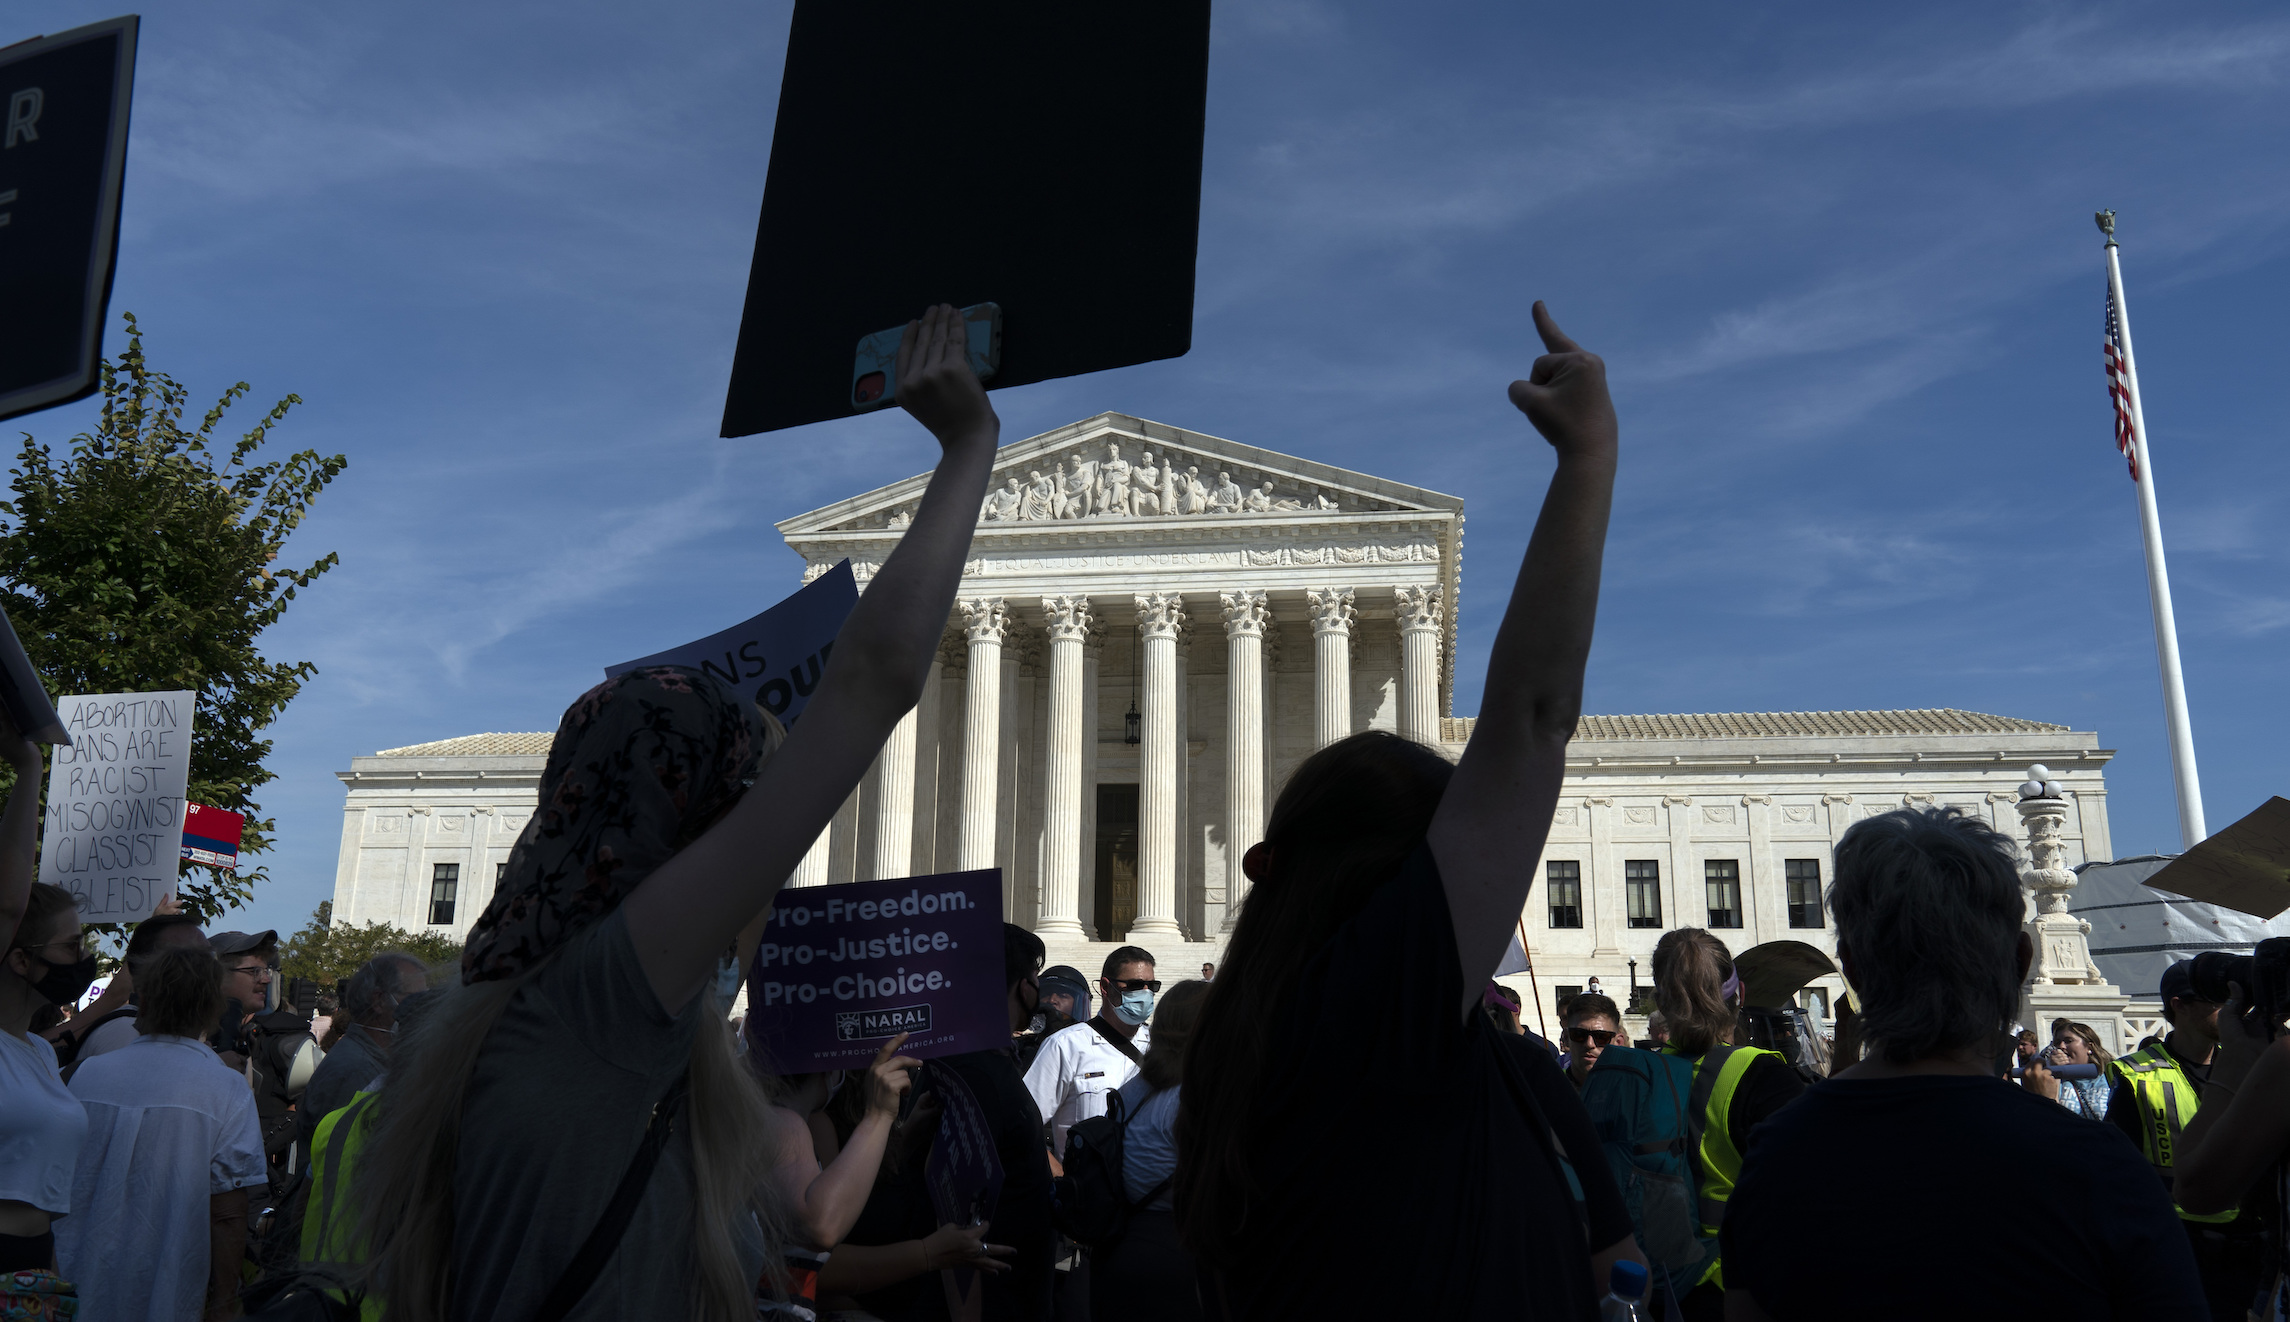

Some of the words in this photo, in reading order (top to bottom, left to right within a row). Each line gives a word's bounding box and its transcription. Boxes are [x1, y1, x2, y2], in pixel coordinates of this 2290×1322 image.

[995, 558, 1051, 571] EQUAL
[1056, 555, 1124, 569] JUSTICE
[1133, 553, 1190, 566] UNDER
[1197, 551, 1232, 564] LAW
[701, 641, 766, 684] NS
[68, 699, 177, 731] ABORTION
[125, 729, 173, 760] ARE
[69, 766, 166, 797] RACIST
[45, 796, 184, 833] MISOGYNIST
[189, 804, 201, 814] 97
[55, 834, 164, 874] CLASSIST
[761, 928, 958, 967] Pro-Justice.
[764, 968, 952, 1006] Pro-Choice.
[865, 1010, 926, 1028] NARAL
[866, 1025, 902, 1034] PRO-CHOICE
[903, 1023, 926, 1031] AMERICA
[814, 1035, 955, 1058] WWW.PROCHOAMERICA.ORG
[929, 1064, 992, 1180] Reproductive
[936, 1085, 972, 1166] Freedom
[2153, 1108, 2171, 1164] USCP
